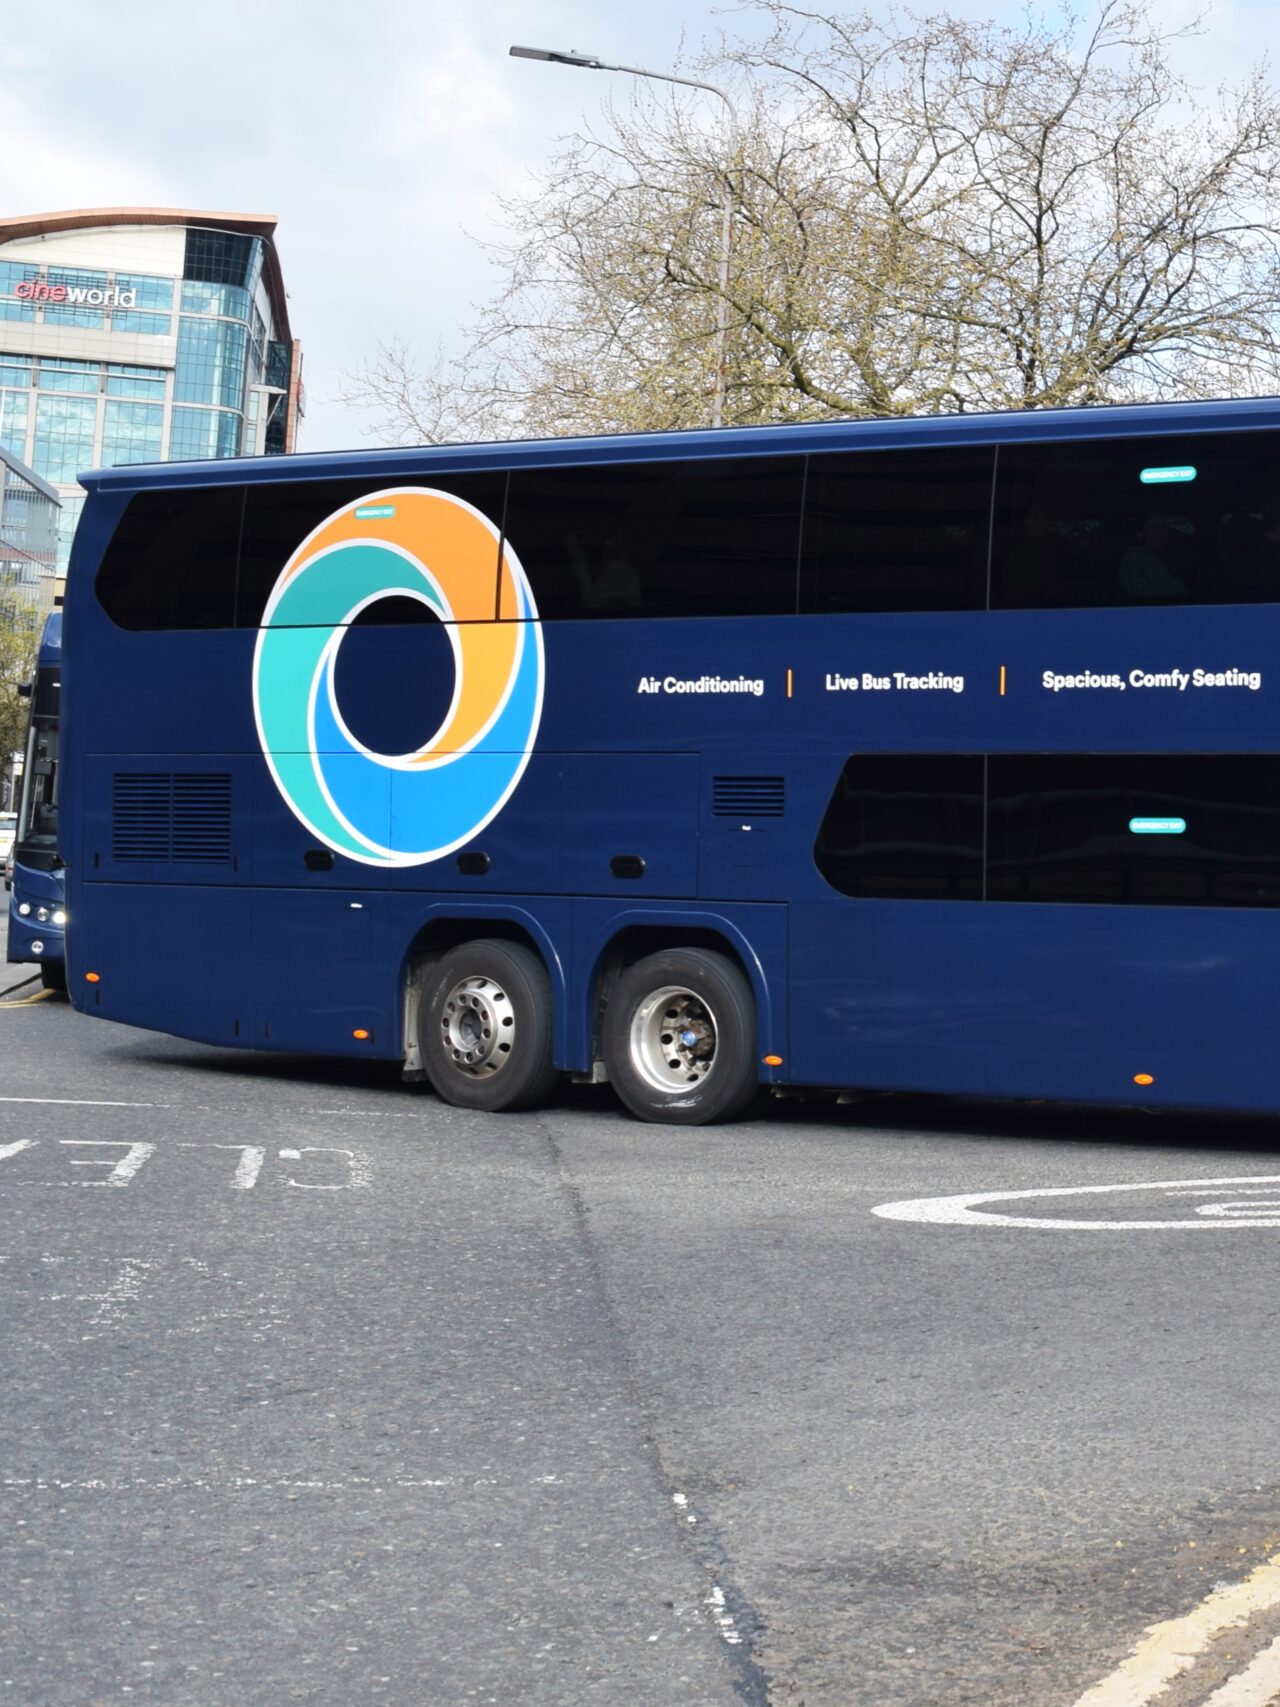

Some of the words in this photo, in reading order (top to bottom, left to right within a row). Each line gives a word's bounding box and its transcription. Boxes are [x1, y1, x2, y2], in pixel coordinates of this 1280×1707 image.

[15, 279, 136, 308] cineworld
[637, 677, 661, 695] Air
[663, 676, 764, 697] Conditioning
[825, 673, 858, 691] Live
[861, 673, 891, 691] Bus
[895, 671, 964, 693] Tracking
[1042, 670, 1126, 692] Spacious,
[1129, 668, 1190, 691] Comfy
[1192, 667, 1261, 690] Seating
